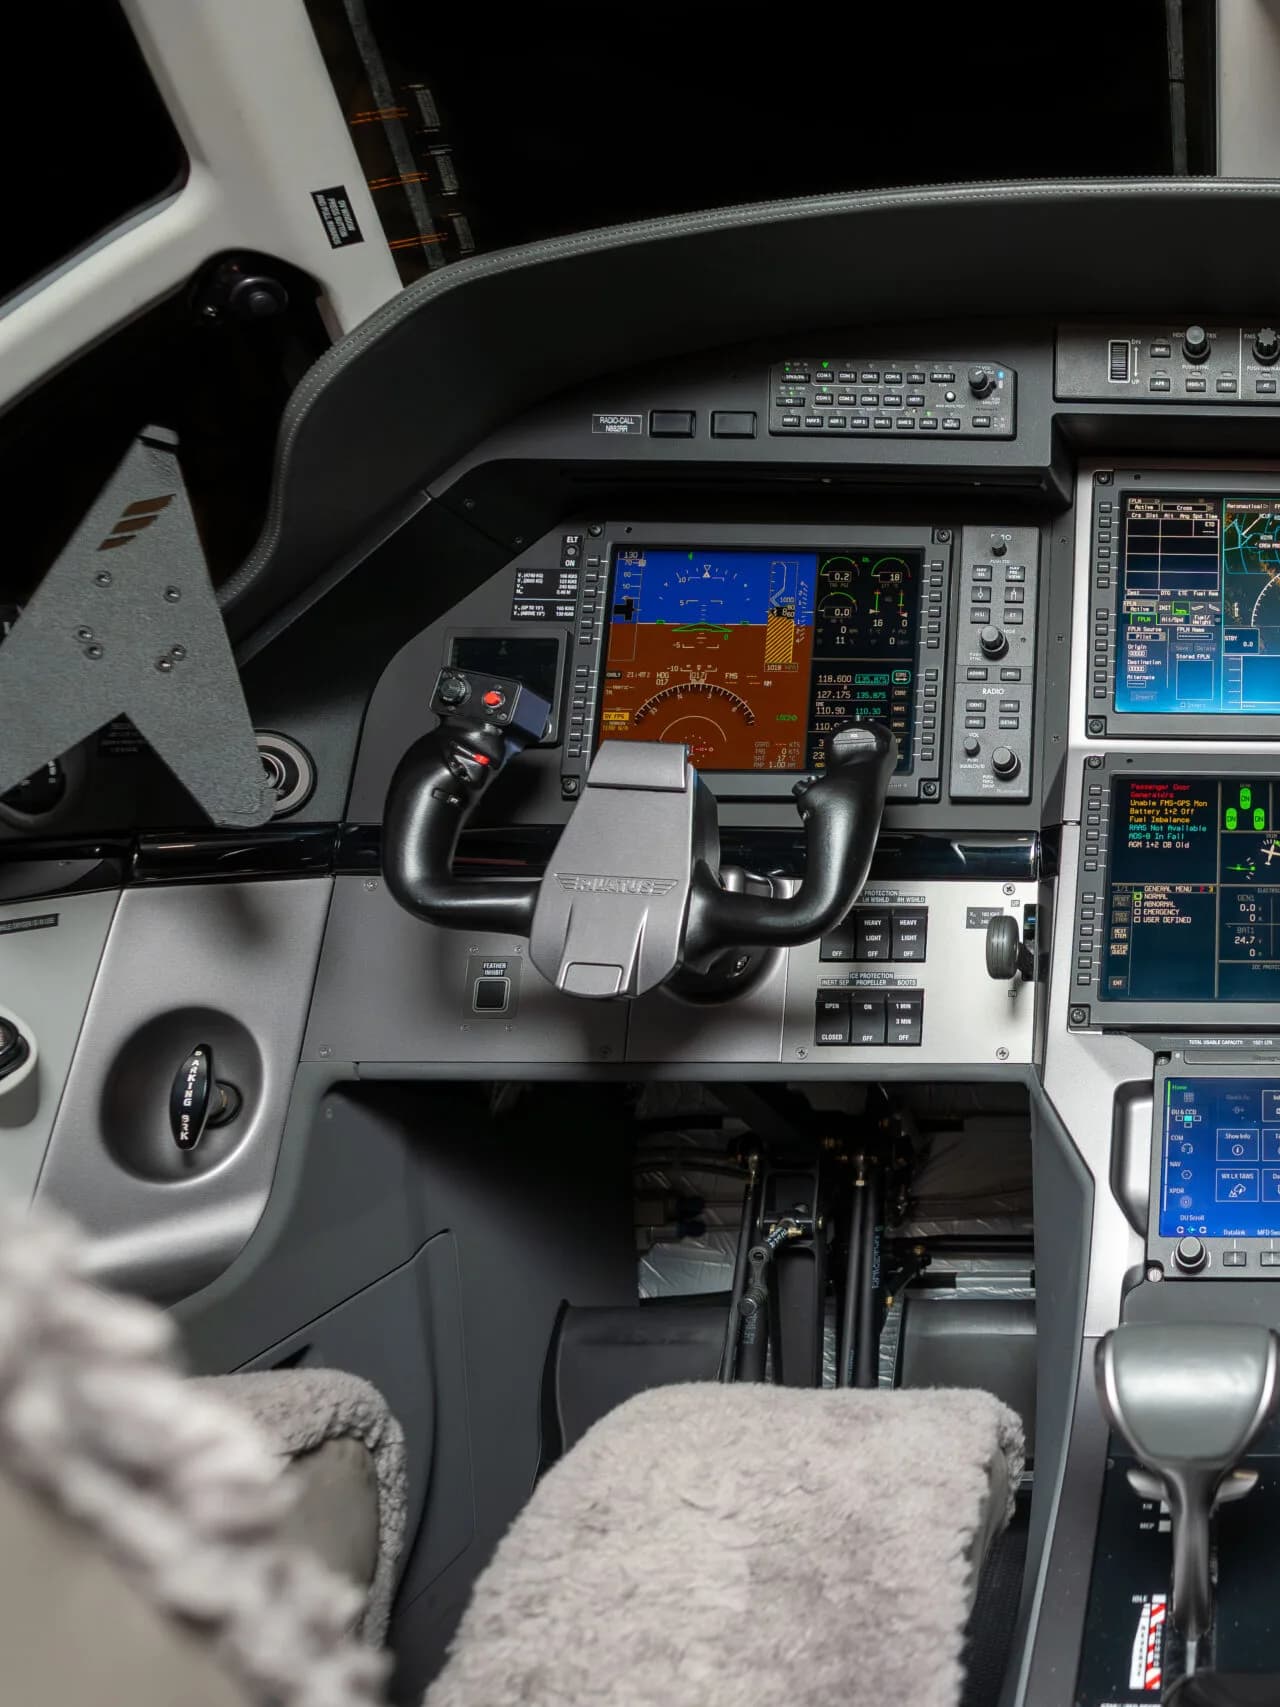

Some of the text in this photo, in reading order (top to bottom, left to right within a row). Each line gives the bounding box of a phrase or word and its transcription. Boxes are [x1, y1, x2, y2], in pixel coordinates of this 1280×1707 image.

[565, 559, 576, 567] ON
[834, 572, 850, 581] 0.2
[834, 608, 850, 616] 0.0
[818, 674, 852, 683] 118.600
[817, 690, 851, 699] 127.175
[1130, 799, 1156, 807] Unable
[1160, 799, 1191, 807] FMS-GPS
[1130, 808, 1160, 816] Battery
[1129, 816, 1191, 824] Fuel Imbalance
[1239, 904, 1256, 912] 0.0
[1234, 936, 1256, 945] 24.7
[821, 1033, 843, 1041] CLOSED
